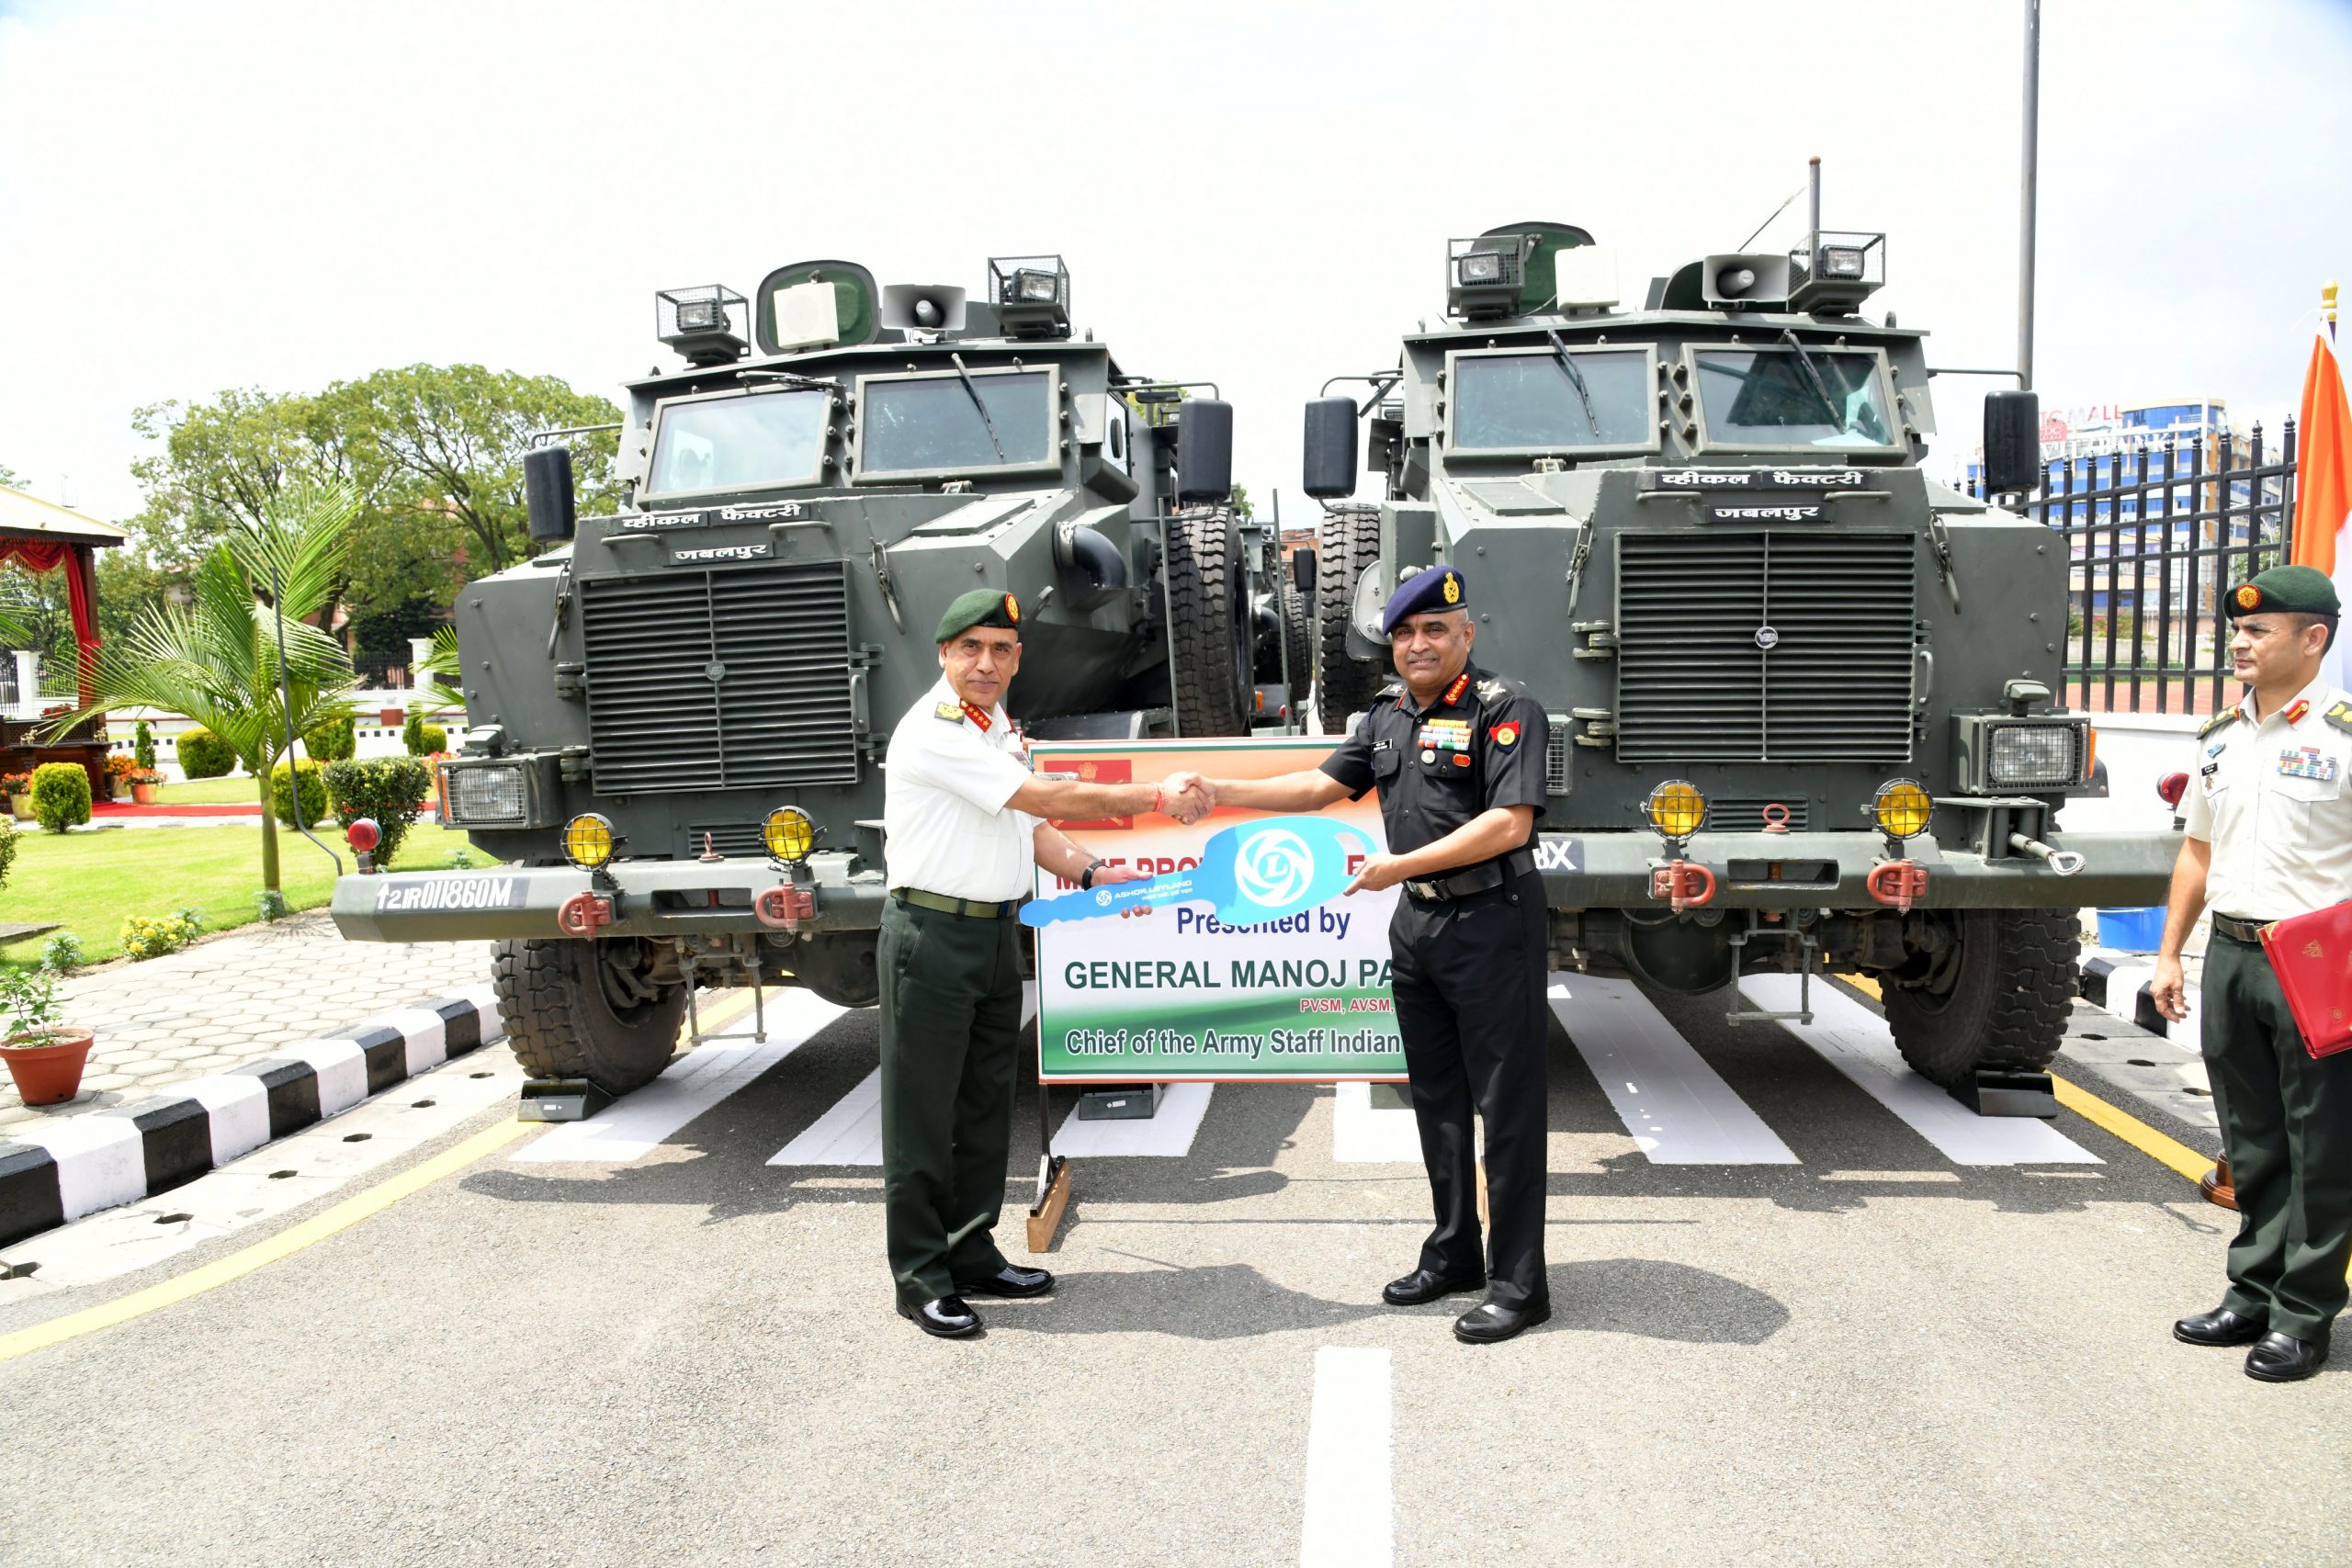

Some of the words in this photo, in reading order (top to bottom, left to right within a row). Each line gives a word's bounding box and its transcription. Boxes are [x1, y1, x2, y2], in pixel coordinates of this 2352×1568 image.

[2067, 404, 2123, 423] MALL
[1662, 470, 1751, 485] व्हीकल
[1772, 470, 1864, 485] फैक्टरी
[622, 513, 701, 528] व्हीकल
[720, 504, 801, 521] फैक्टरी
[1714, 506, 1819, 521] जबलपुर
[674, 544, 767, 560] जबलपुर
[1114, 887, 1148, 900] ASHOK
[1148, 879, 1193, 894] LEYLAND
[1319, 906, 1351, 941] by
[1065, 961, 1221, 989] GENERAL
[1231, 959, 1347, 988] MANOJ
[1300, 998, 1345, 1013] PVSM,
[1350, 998, 1395, 1013] AVSM,
[1067, 1029, 1126, 1055] Chief
[1131, 1029, 1156, 1055] of
[1159, 1029, 1196, 1055] the
[1202, 1029, 1263, 1060] Army
[1270, 1029, 1325, 1055] Staff
[1330, 1029, 1401, 1054] Indian
